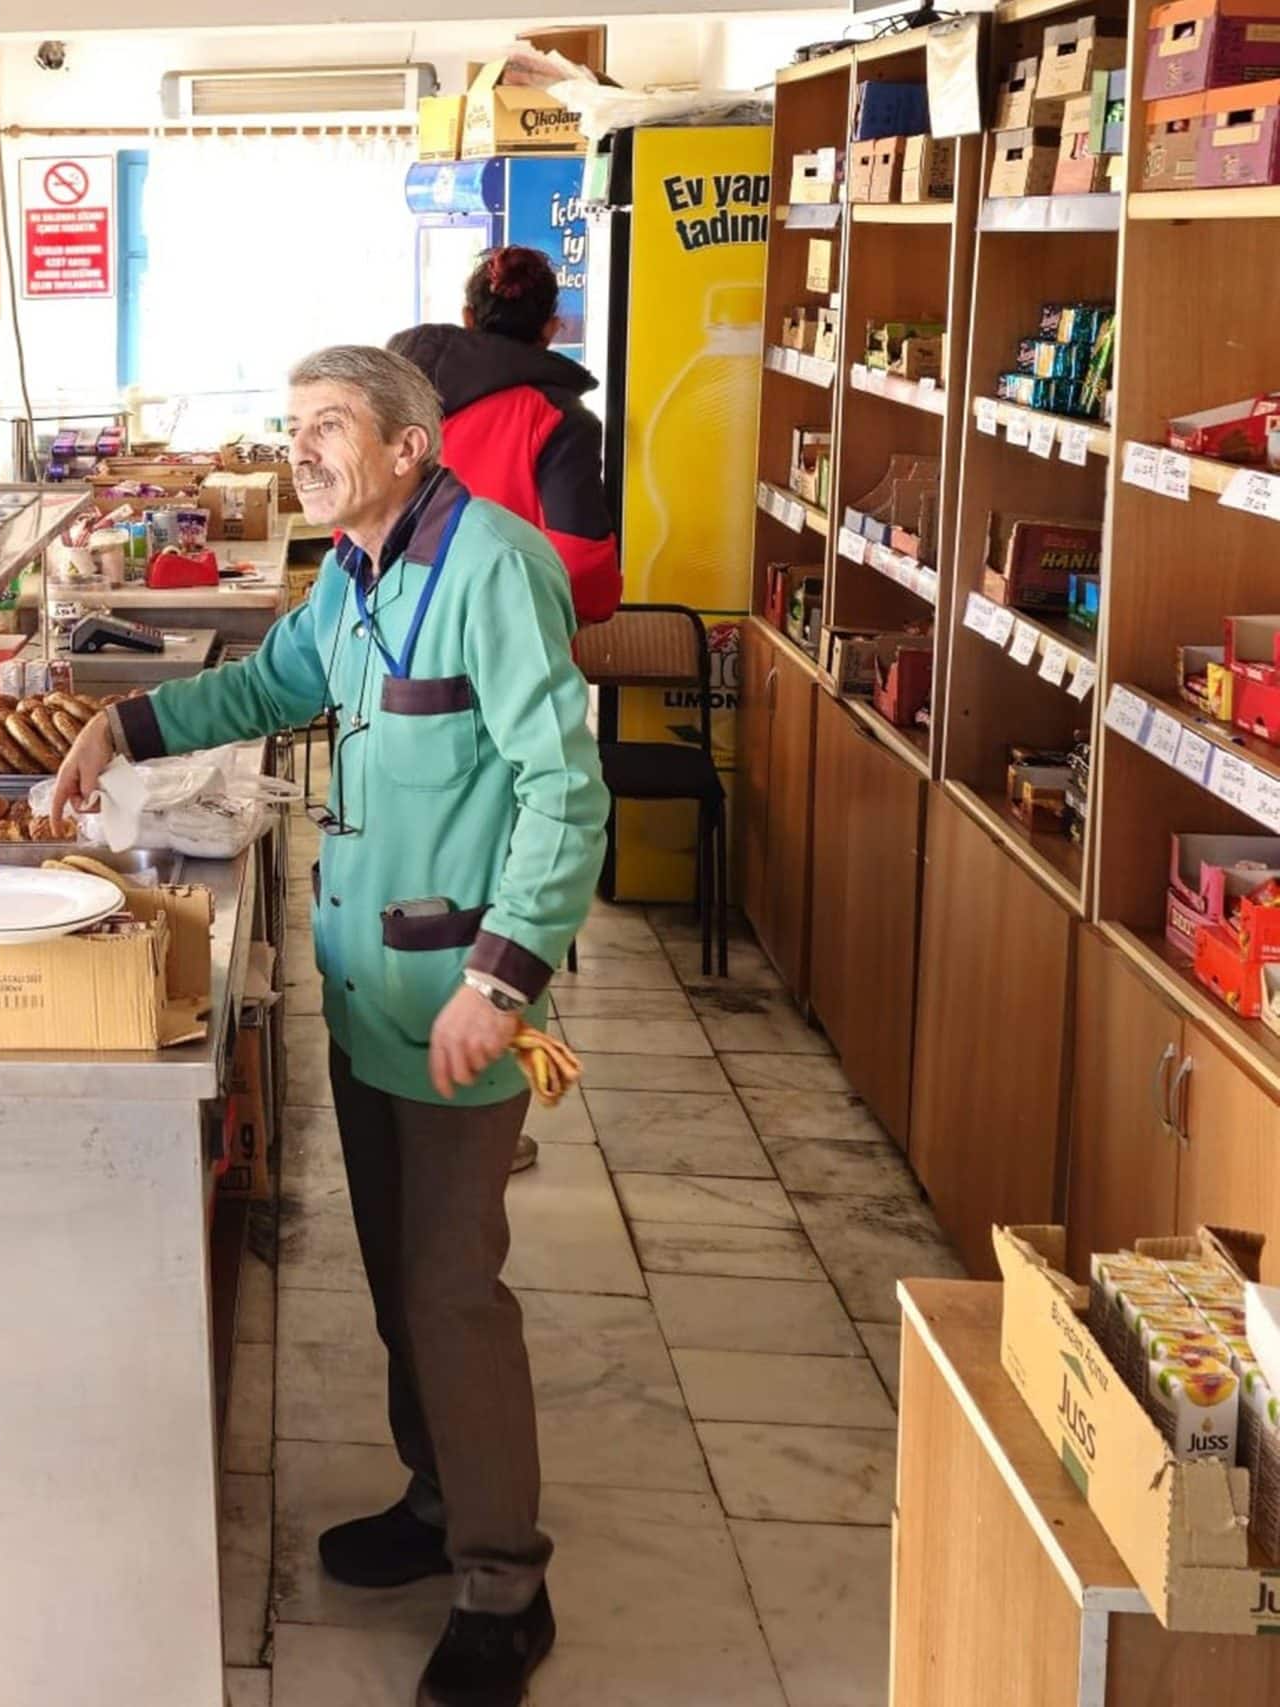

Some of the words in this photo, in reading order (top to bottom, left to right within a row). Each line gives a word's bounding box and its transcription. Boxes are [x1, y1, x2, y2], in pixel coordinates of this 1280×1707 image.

[664, 175, 704, 212] Ev
[1057, 1372, 1096, 1461] Juss
[1187, 1433, 1229, 1453] Juss
